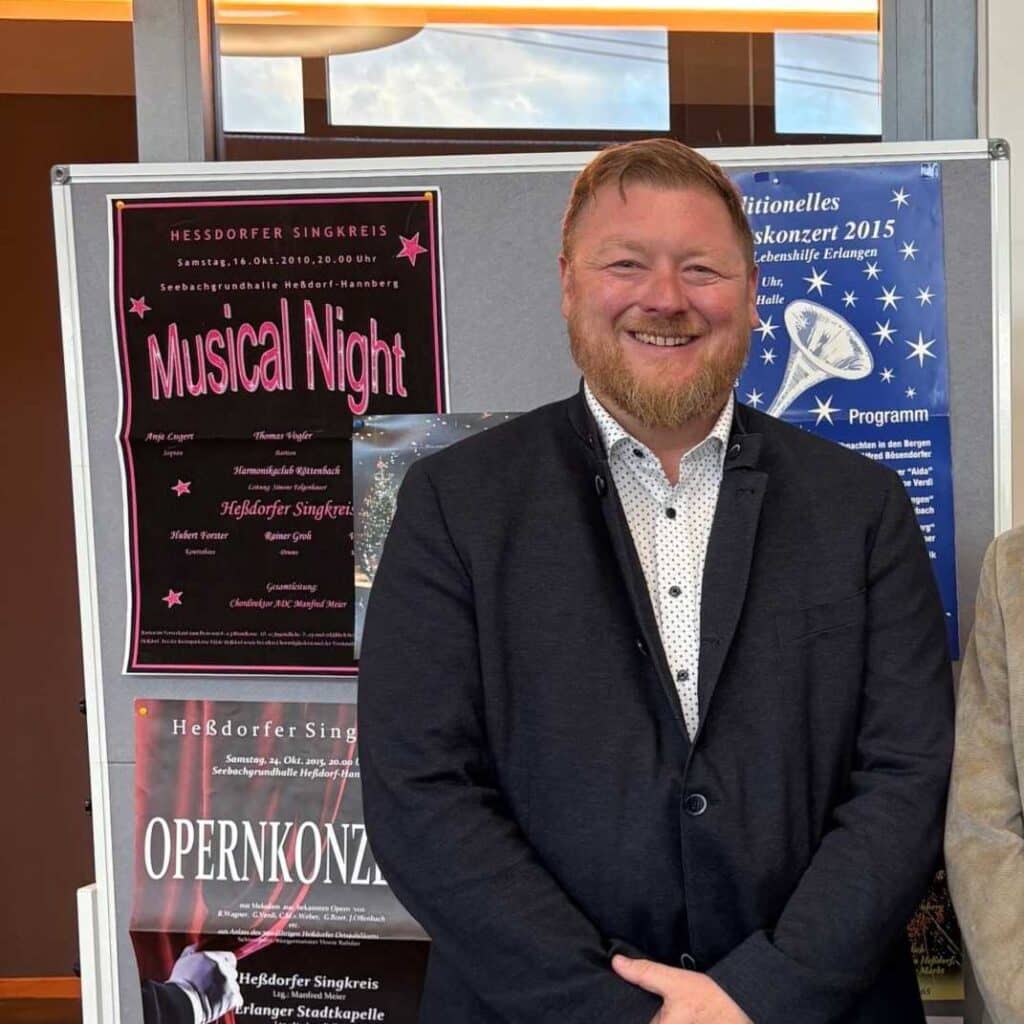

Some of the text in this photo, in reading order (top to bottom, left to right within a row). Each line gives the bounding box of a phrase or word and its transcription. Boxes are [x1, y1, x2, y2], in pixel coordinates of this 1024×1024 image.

[741, 193, 840, 214] itionelles
[170, 224, 387, 241] HESSDORFER SINGKREIS
[754, 219, 895, 243] skonzert 2015
[356, 254, 377, 264] Uhr
[754, 247, 877, 264] Lebenshilfe Erlangen
[160, 281, 278, 292] Seebachgrundhalle
[762, 276, 783, 288] Uhr,
[147, 298, 407, 415] Musical Night
[850, 409, 928, 427] Programm
[904, 440, 931, 449] Bergen
[219, 501, 354, 520] Heßdorfer Singkreis
[172, 719, 357, 743] Heßdorfer Sing
[225, 753, 304, 766] Samstag, Okt.
[212, 767, 298, 779] Seebachgrundhalle
[144, 816, 387, 885] OPERNKONZ
[239, 972, 379, 991] Heßdorfer Singkreis
[235, 1003, 385, 1024] Erlanger Stadtkapelle
